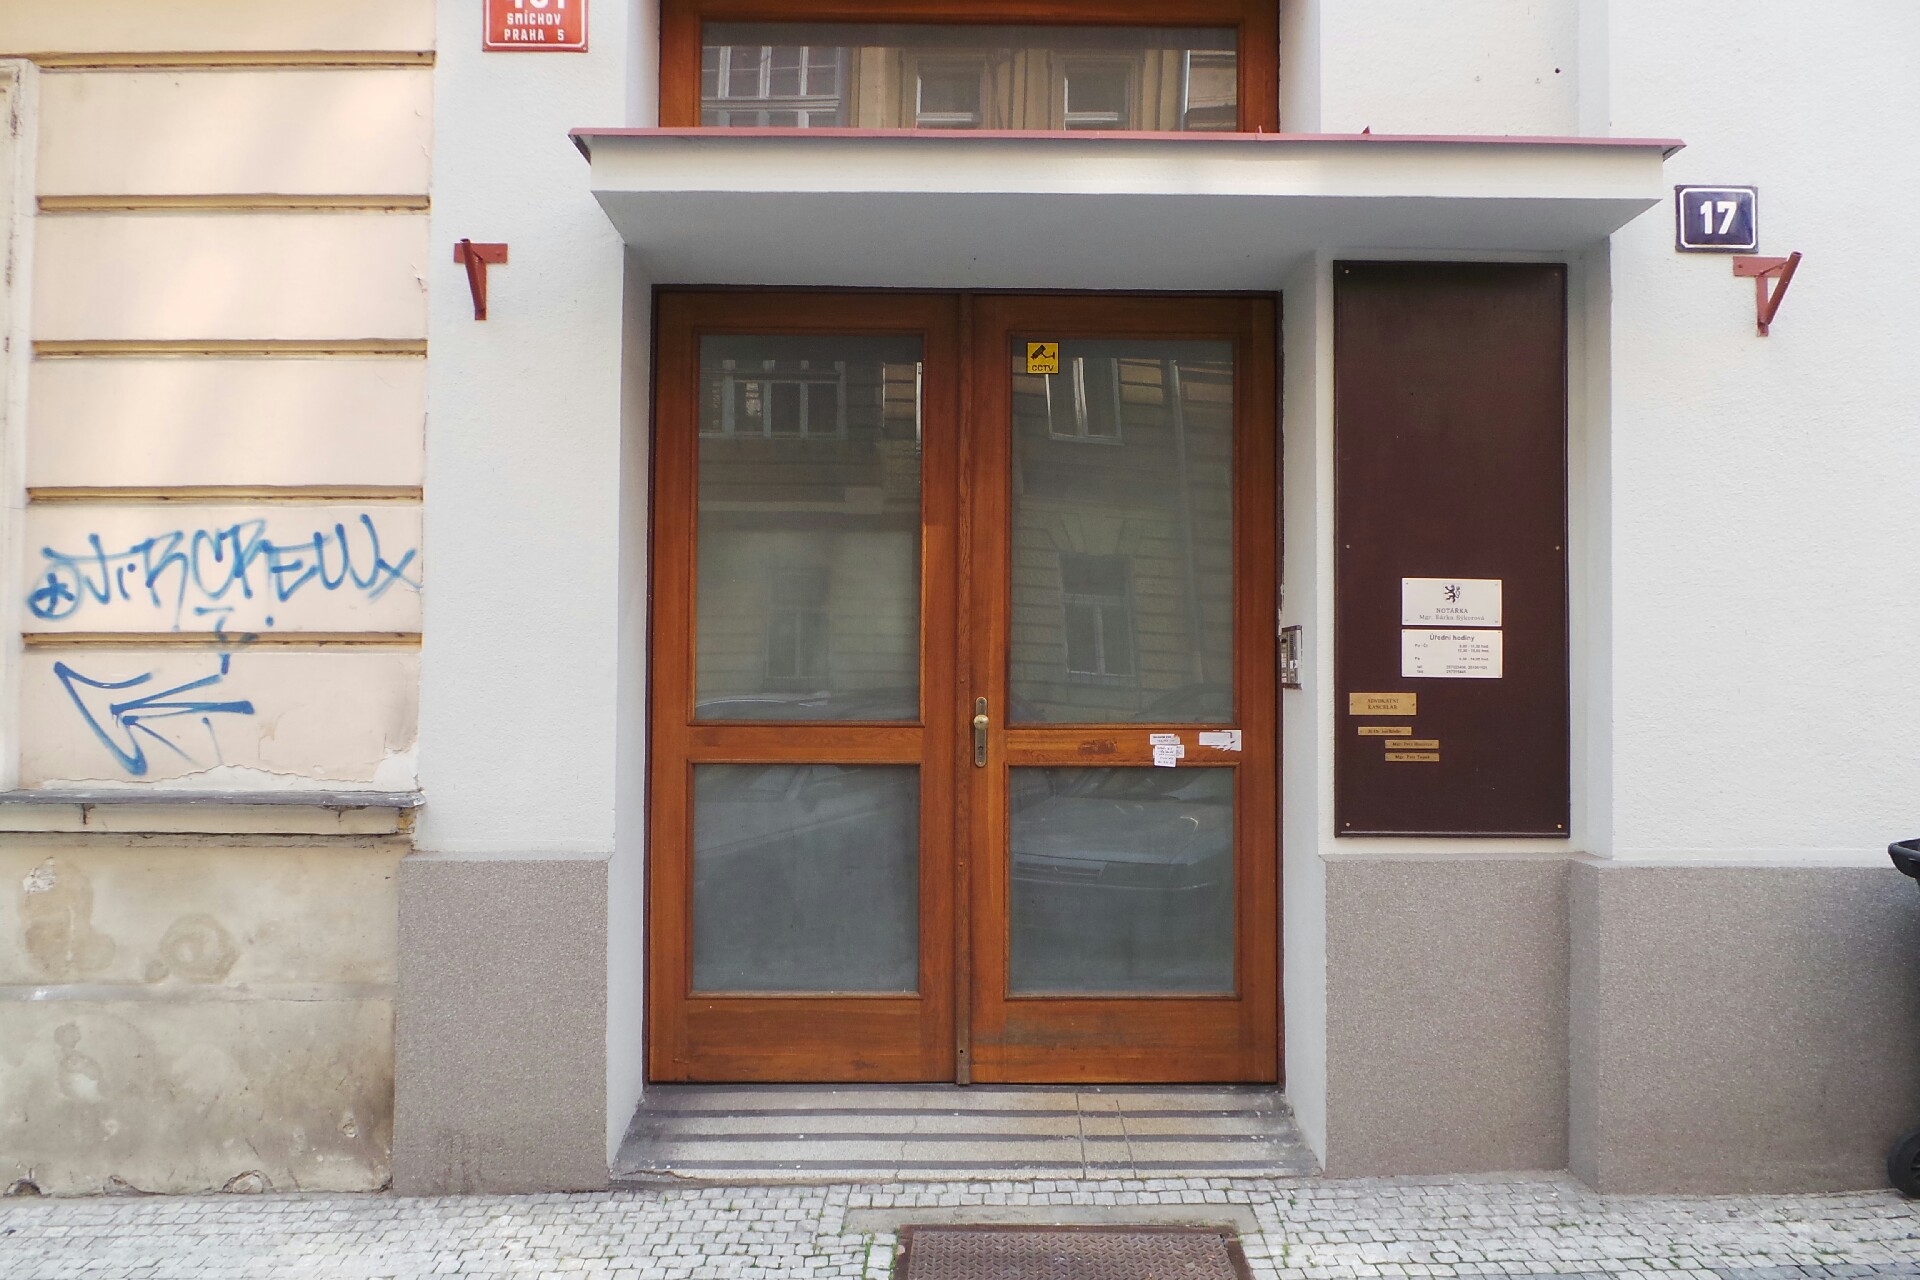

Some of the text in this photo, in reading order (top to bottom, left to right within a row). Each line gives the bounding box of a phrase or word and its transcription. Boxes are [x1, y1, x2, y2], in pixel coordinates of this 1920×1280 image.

[504, 28, 565, 41] PRAHA 5
[1700, 200, 1737, 235] 17
[1031, 364, 1055, 372] CCTV
[1452, 634, 1475, 642] hodiny
